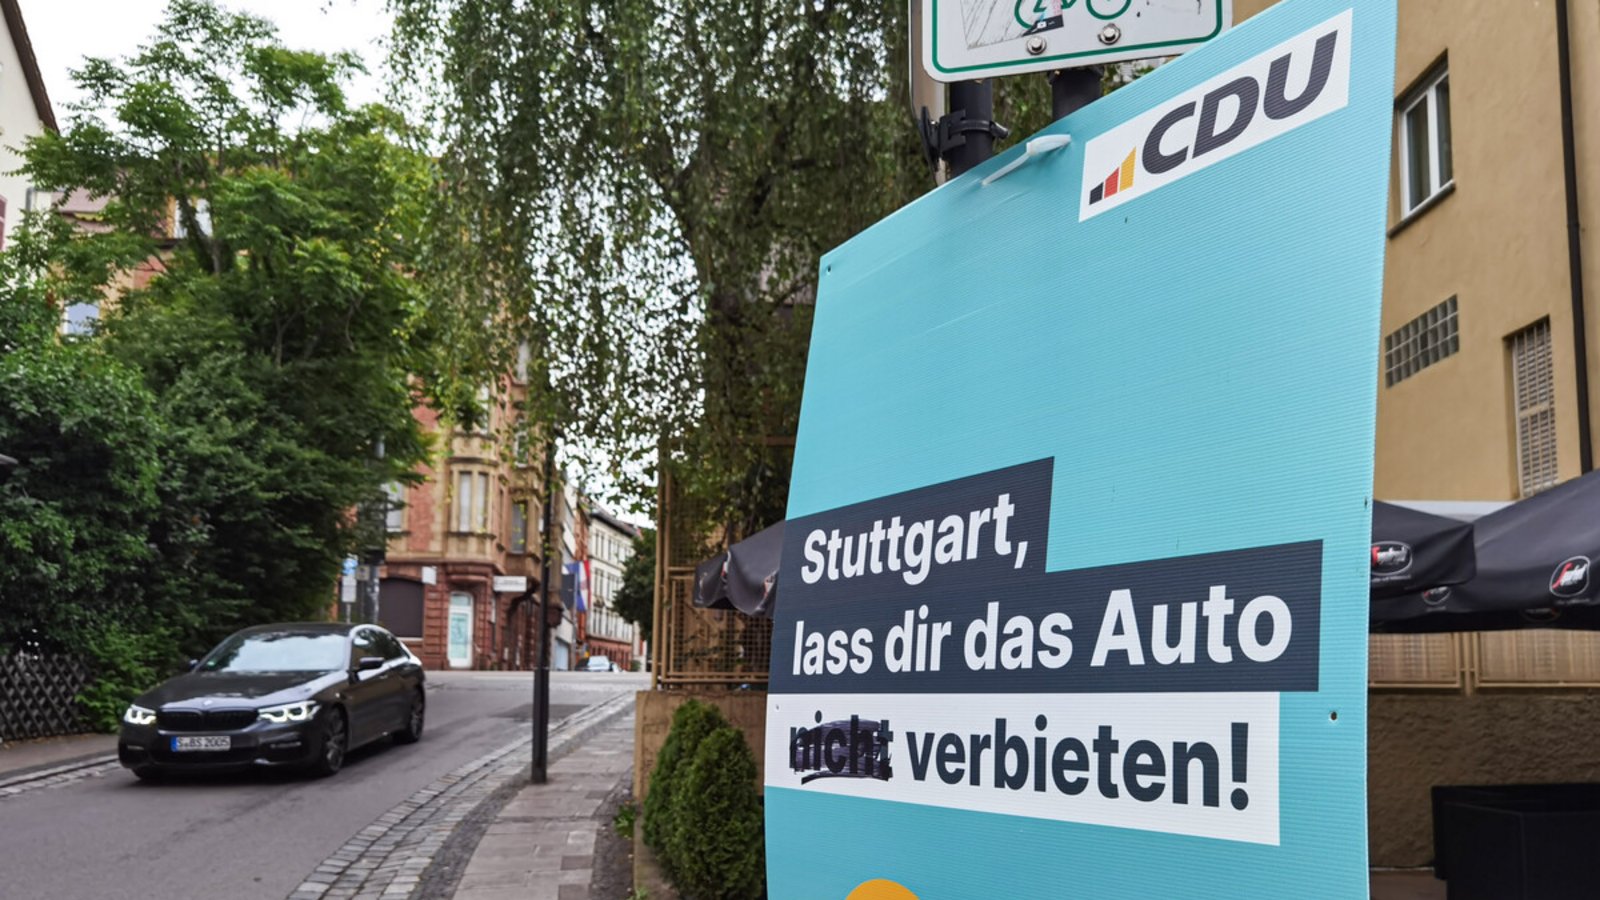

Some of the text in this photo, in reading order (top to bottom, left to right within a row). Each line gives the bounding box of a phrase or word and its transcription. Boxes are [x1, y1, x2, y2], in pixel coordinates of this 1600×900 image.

[1141, 30, 1338, 174] CDU
[801, 493, 1028, 585] Stuttgart,
[793, 585, 1293, 675] lass dir das Auto
[906, 714, 1249, 810] verbieten!
